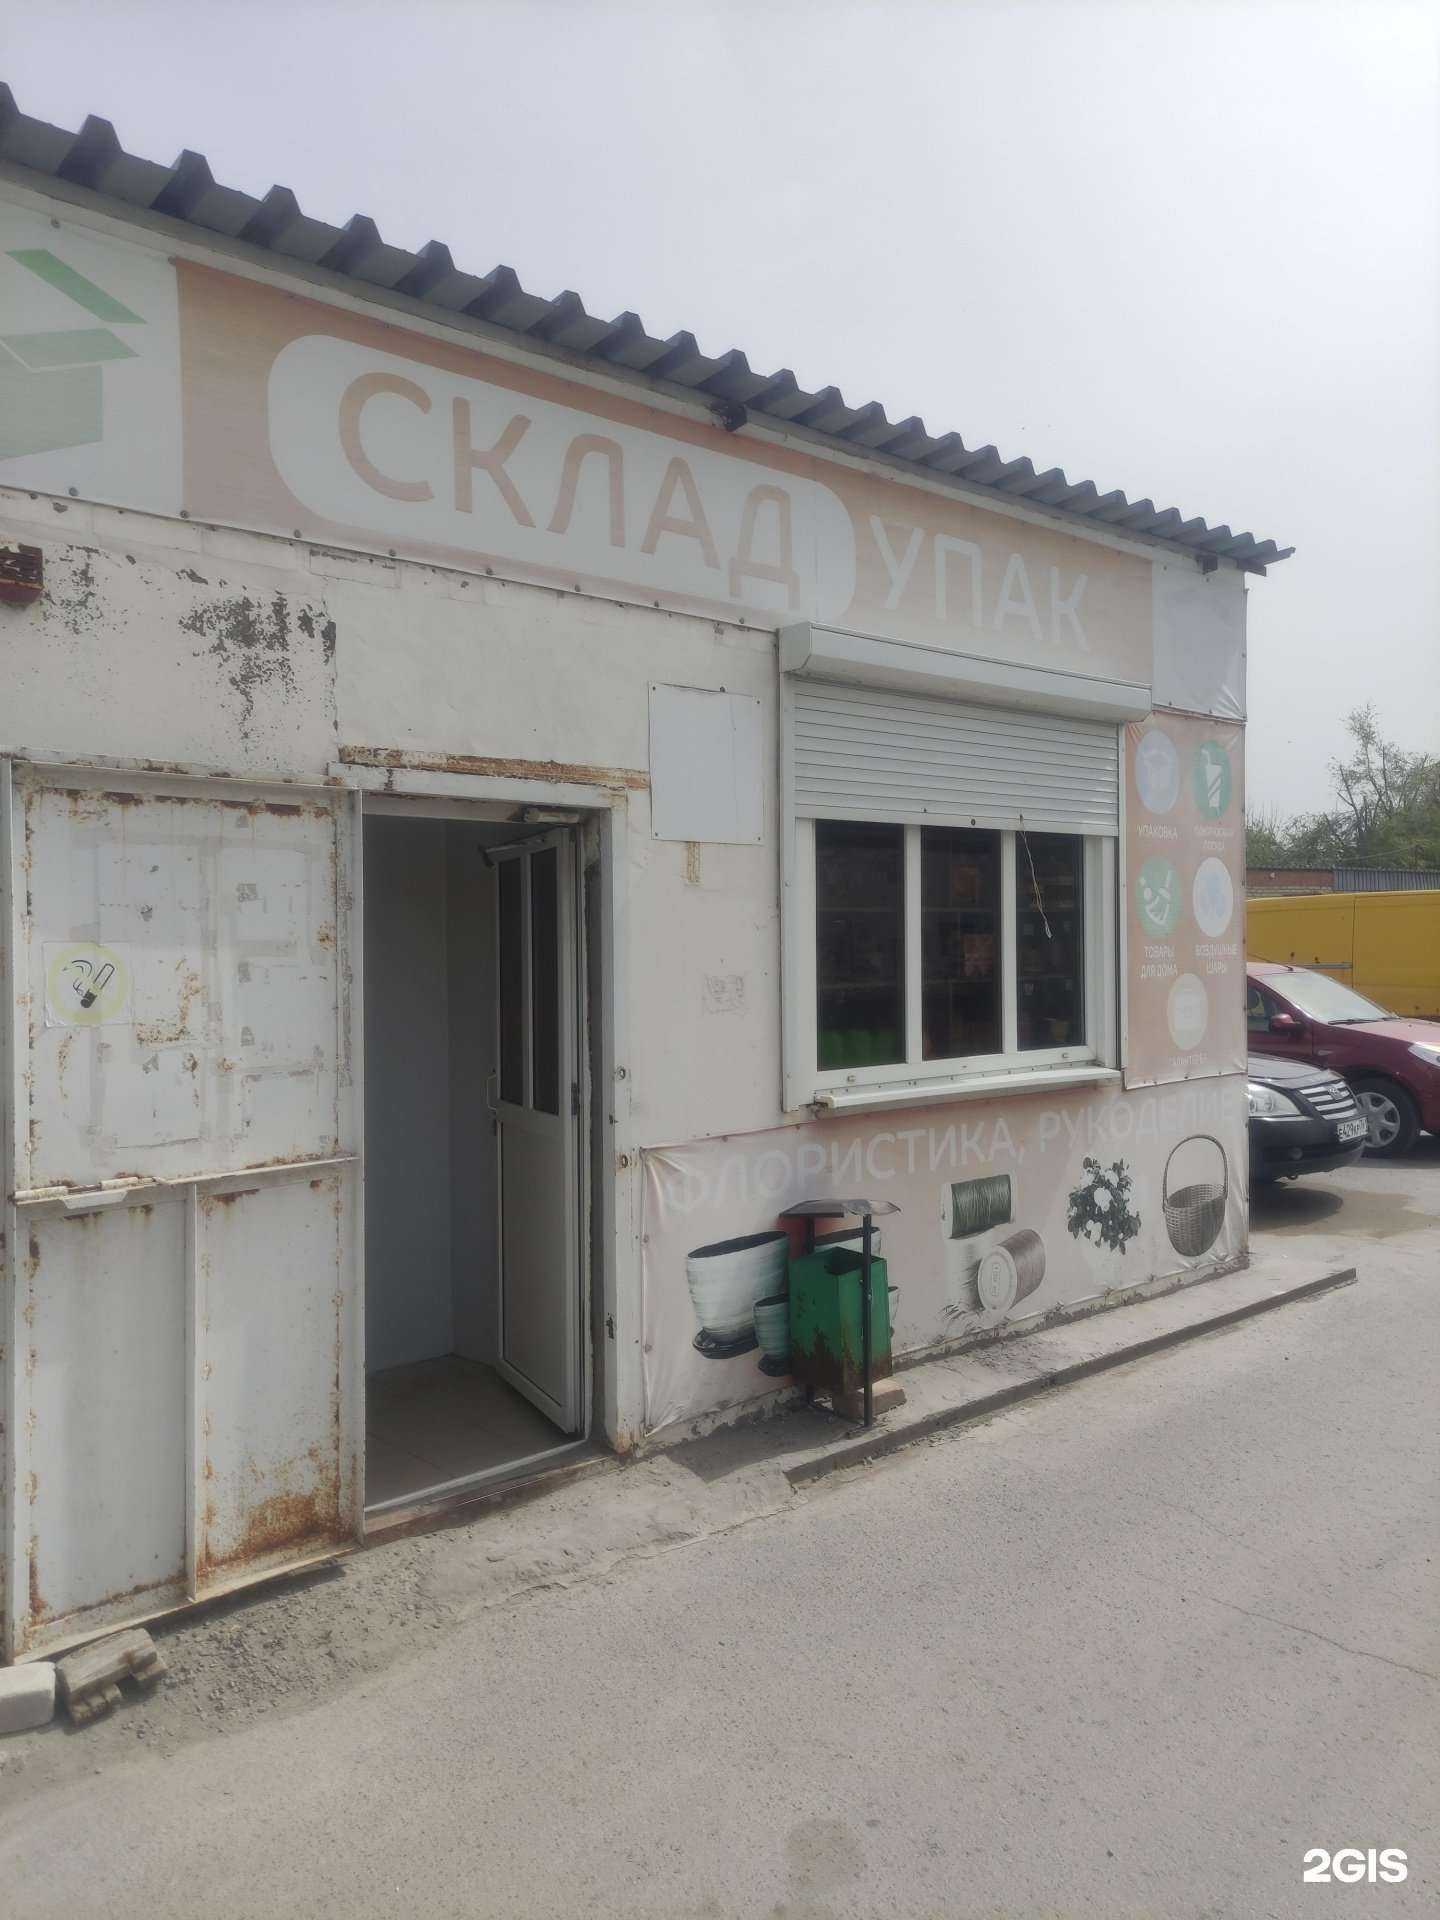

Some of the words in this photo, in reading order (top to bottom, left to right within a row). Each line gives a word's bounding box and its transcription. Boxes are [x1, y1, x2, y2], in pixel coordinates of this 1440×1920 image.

[337, 371, 801, 606] СКЛАД
[869, 513, 1089, 650] УПАК
[1136, 823, 1178, 840] УПАКОВКА
[1039, 1089, 1234, 1153] РУКОДЕЛИЕ
